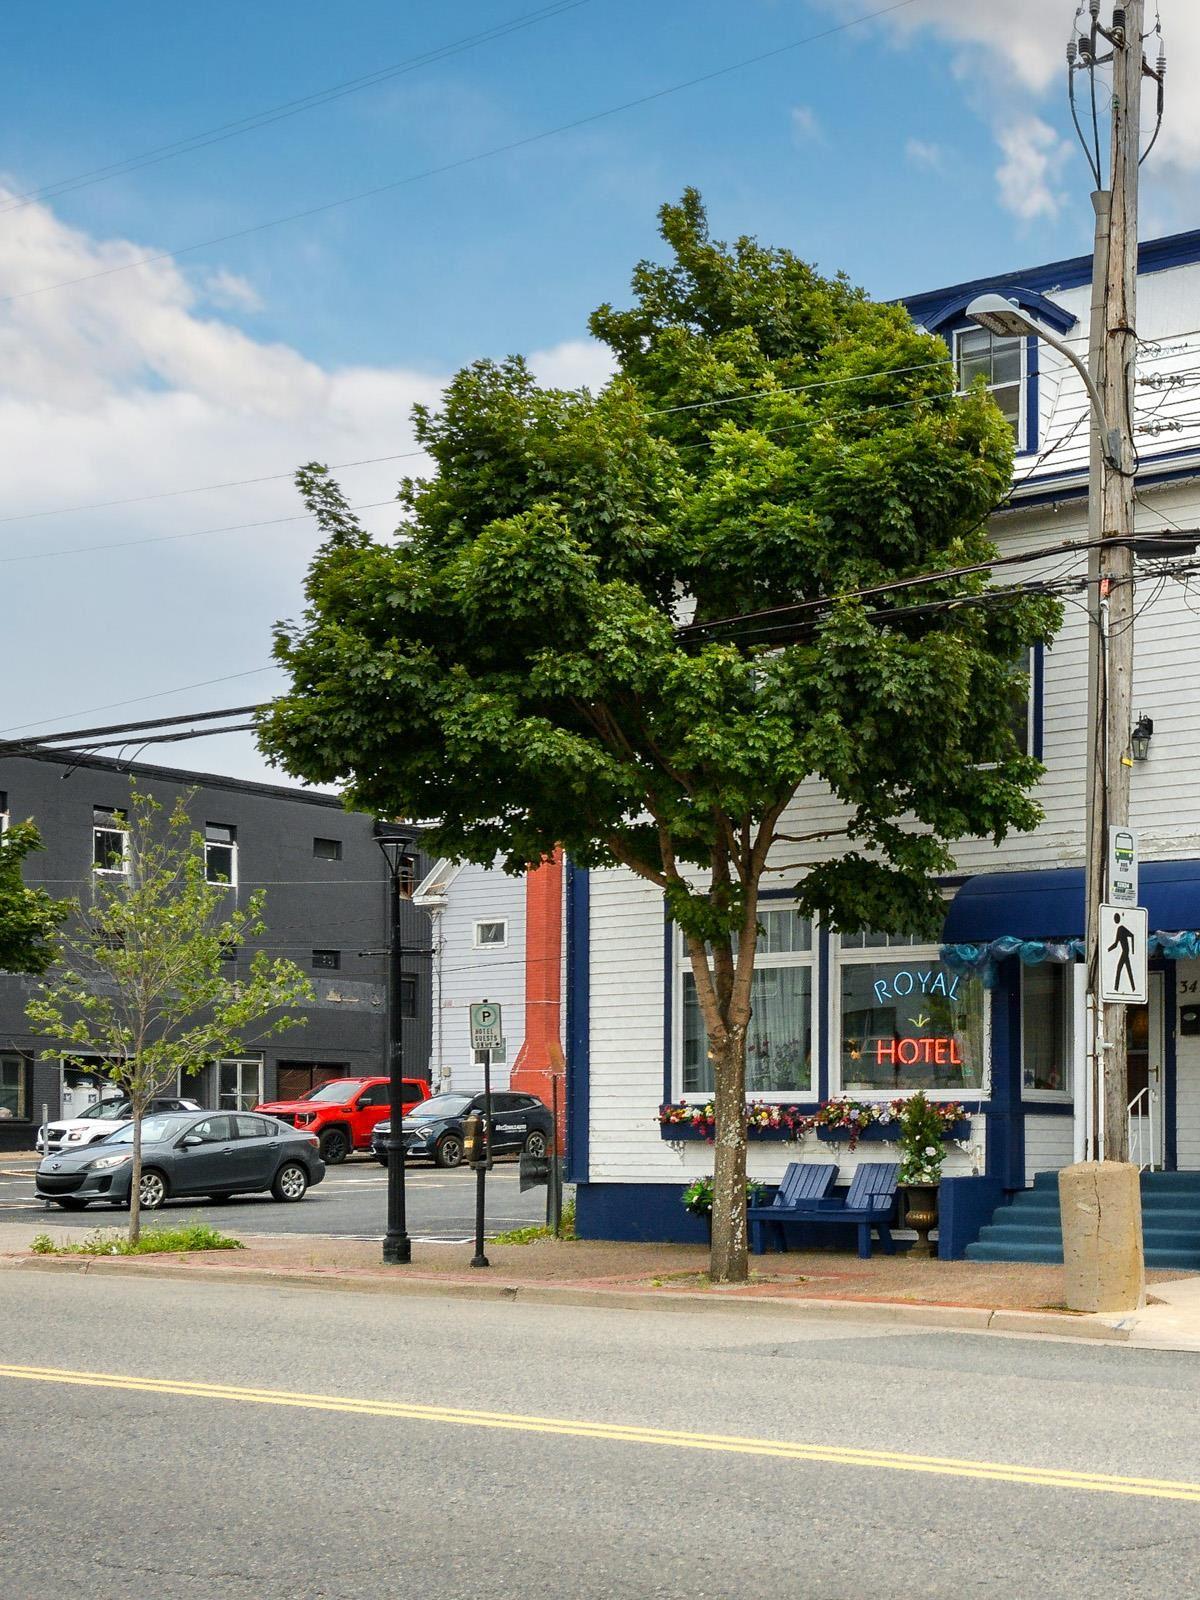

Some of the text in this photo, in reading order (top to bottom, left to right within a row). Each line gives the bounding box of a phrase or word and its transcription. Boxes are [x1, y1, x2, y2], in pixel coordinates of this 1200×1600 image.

[873, 970, 960, 1004] ROYAL
[482, 1011, 491, 1022] P
[876, 1038, 963, 1065] HOTEL
